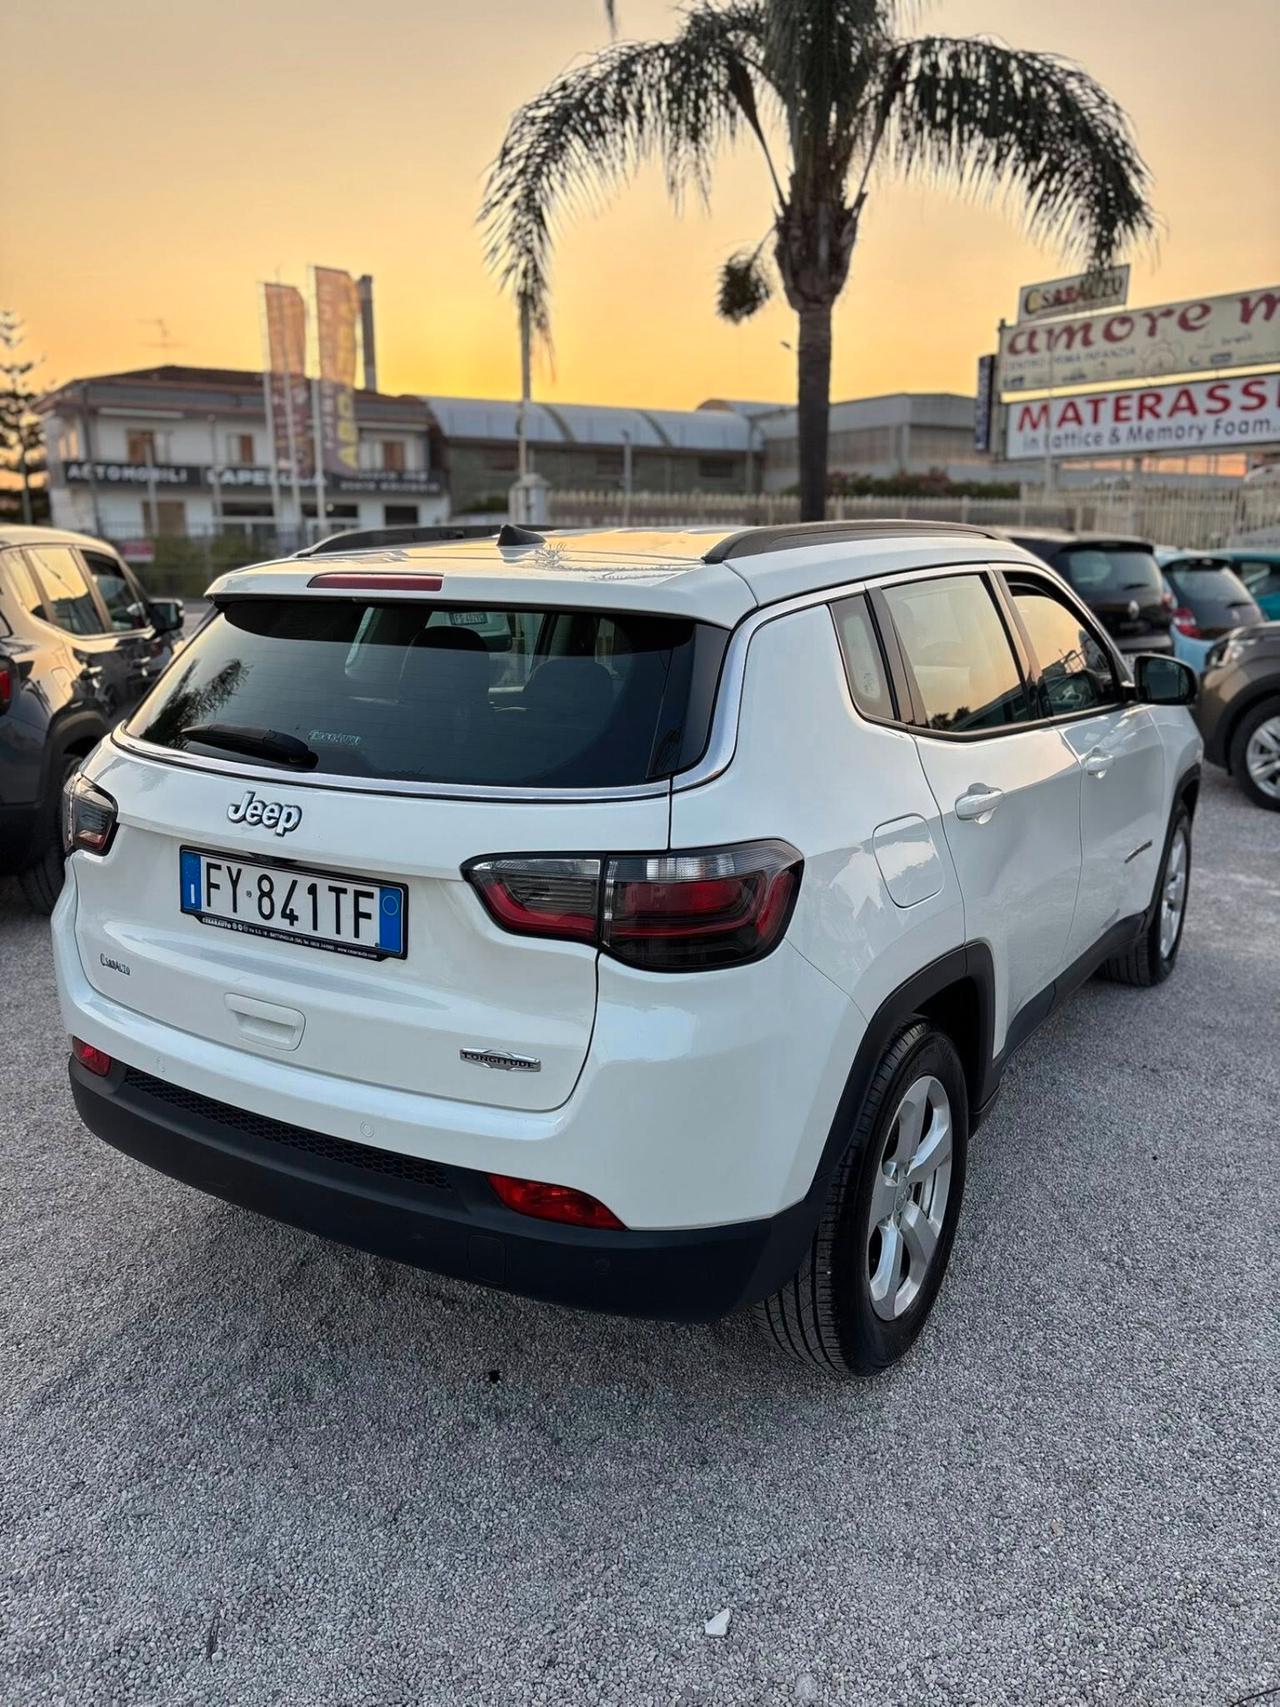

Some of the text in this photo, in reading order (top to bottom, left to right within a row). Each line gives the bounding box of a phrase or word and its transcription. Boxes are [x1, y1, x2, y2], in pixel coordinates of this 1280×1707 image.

[1008, 302, 1211, 356] amore
[1018, 379, 1280, 433] MATERASS
[1044, 431, 1104, 450] attice
[1109, 428, 1121, 445] &
[1126, 424, 1207, 443] Memory
[228, 791, 302, 836] Jeep
[206, 862, 374, 939] FY 841TF
[463, 1051, 536, 1068] LONGITUDE
